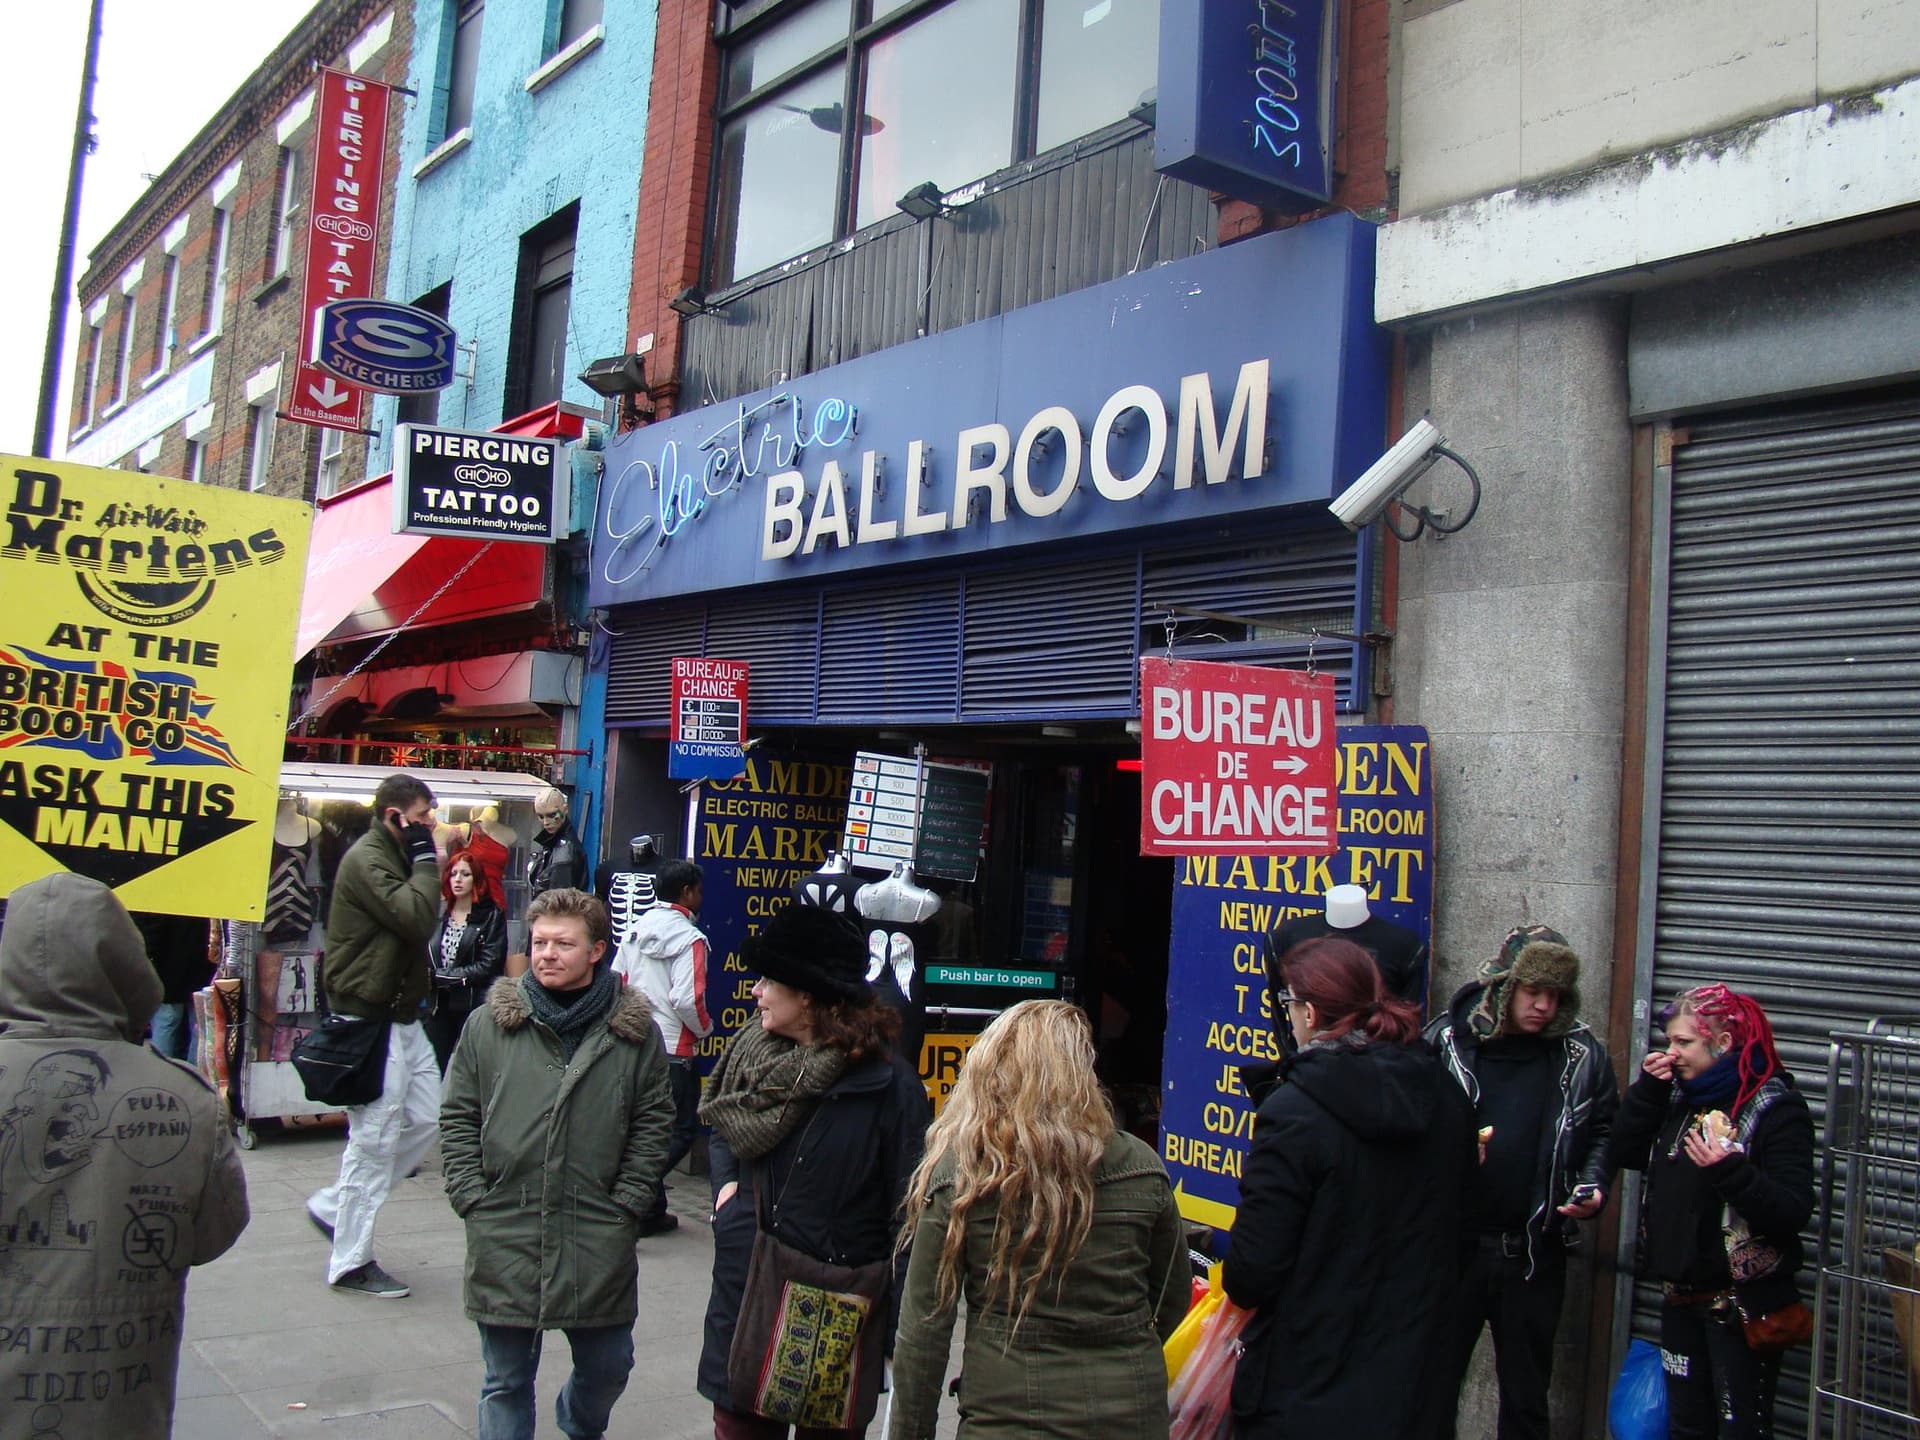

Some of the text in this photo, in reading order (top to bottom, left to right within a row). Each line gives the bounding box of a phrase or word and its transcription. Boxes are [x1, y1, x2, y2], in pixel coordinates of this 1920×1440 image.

[333, 78, 367, 213] PIERCING
[327, 241, 355, 303] TAT
[330, 353, 438, 388] SKECHERS
[294, 405, 356, 425] In the Basement
[415, 433, 550, 466] PIERCING
[761, 358, 1270, 562] BALLROOM
[9, 469, 84, 523] Dr.
[423, 487, 541, 516] TATTOO
[605, 393, 858, 585] Electric
[414, 511, 547, 532] Professional Friendly Hygienic
[2, 513, 286, 578] Martens
[46, 622, 220, 669] AT THE
[677, 660, 746, 681] BUREAU DE
[681, 679, 737, 698] CHANGE
[0, 663, 193, 722] BRITISH
[0, 703, 188, 752] BOOT CO
[1152, 686, 1322, 748] BUREAU
[675, 743, 745, 758] NO COMMISSION
[1216, 751, 1249, 780] DE
[1336, 742, 1428, 796] EN
[0, 761, 236, 819] ASK THIS
[705, 797, 789, 820] ELECTRIC
[1151, 779, 1329, 837] CHANGE
[34, 805, 184, 856] MAN!
[701, 822, 843, 863] MARK
[1233, 943, 1266, 975] CL
[732, 979, 758, 1000] JE
[940, 969, 1042, 987] Push bar to open
[918, 1045, 970, 1080] UR
[1215, 1065, 1250, 1097] JE
[15, 1363, 153, 1400] IDIOTA
